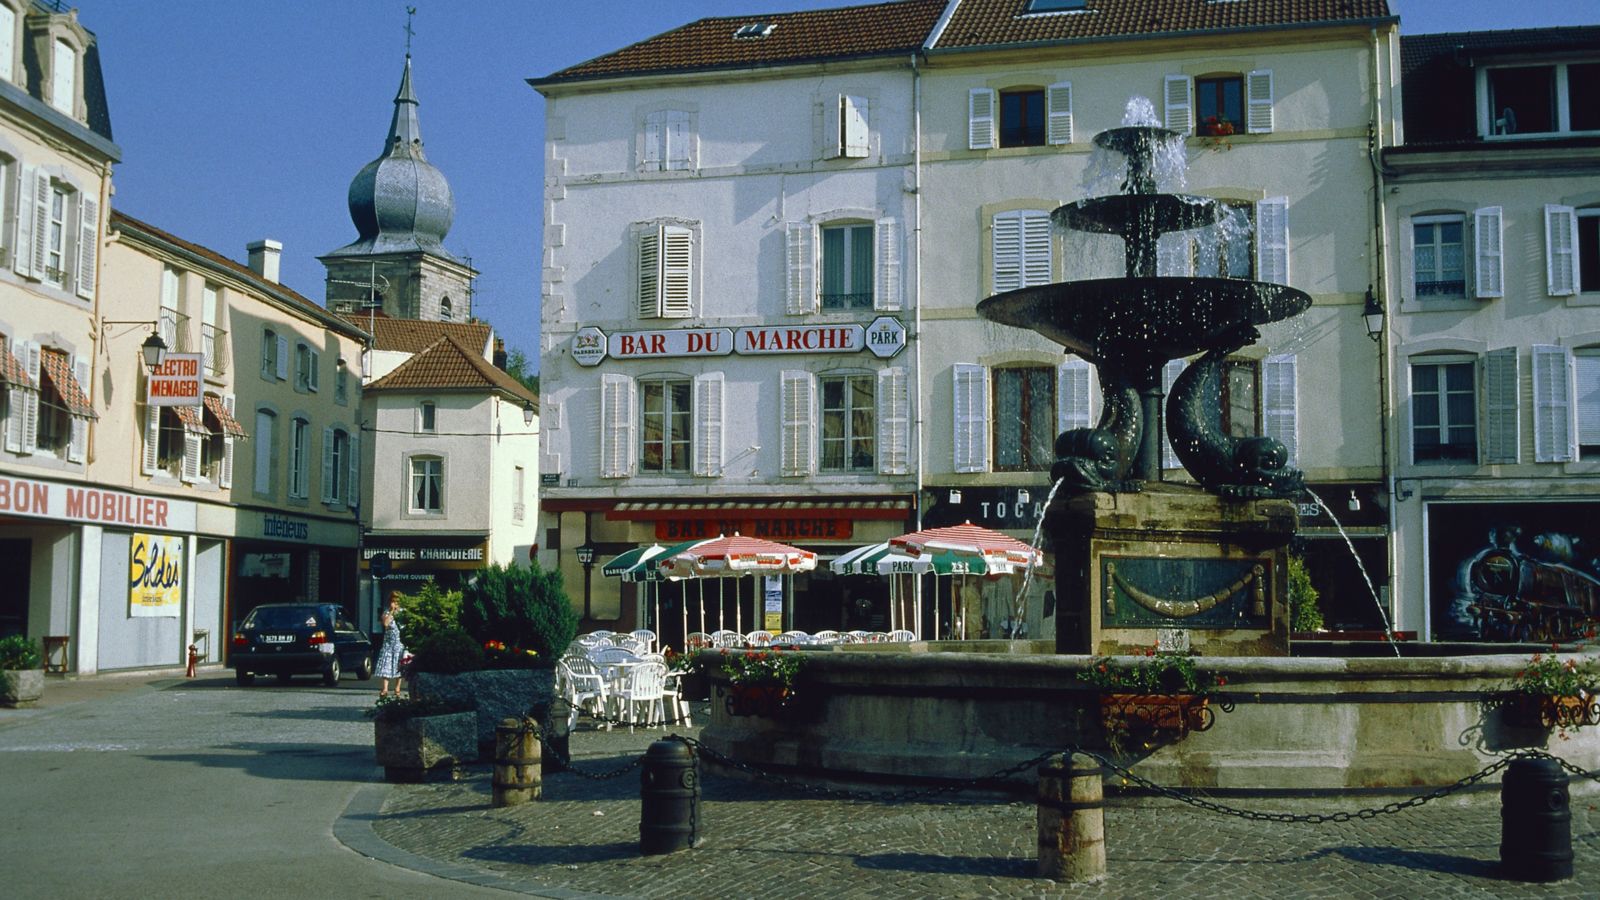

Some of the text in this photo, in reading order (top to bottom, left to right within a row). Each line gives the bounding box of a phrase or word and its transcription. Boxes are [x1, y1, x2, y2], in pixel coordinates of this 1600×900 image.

[620, 328, 854, 355] BAR DU MARCHE
[871, 331, 899, 345] PARK
[151, 380, 199, 398] MENAGER
[0, 479, 169, 527] BON MOBILIER
[668, 519, 706, 538] BAR
[754, 518, 836, 538] MARCHE
[420, 548, 483, 560] CHARCUTERIE
[131, 541, 179, 590] Soldes
[893, 561, 914, 572] PARK
